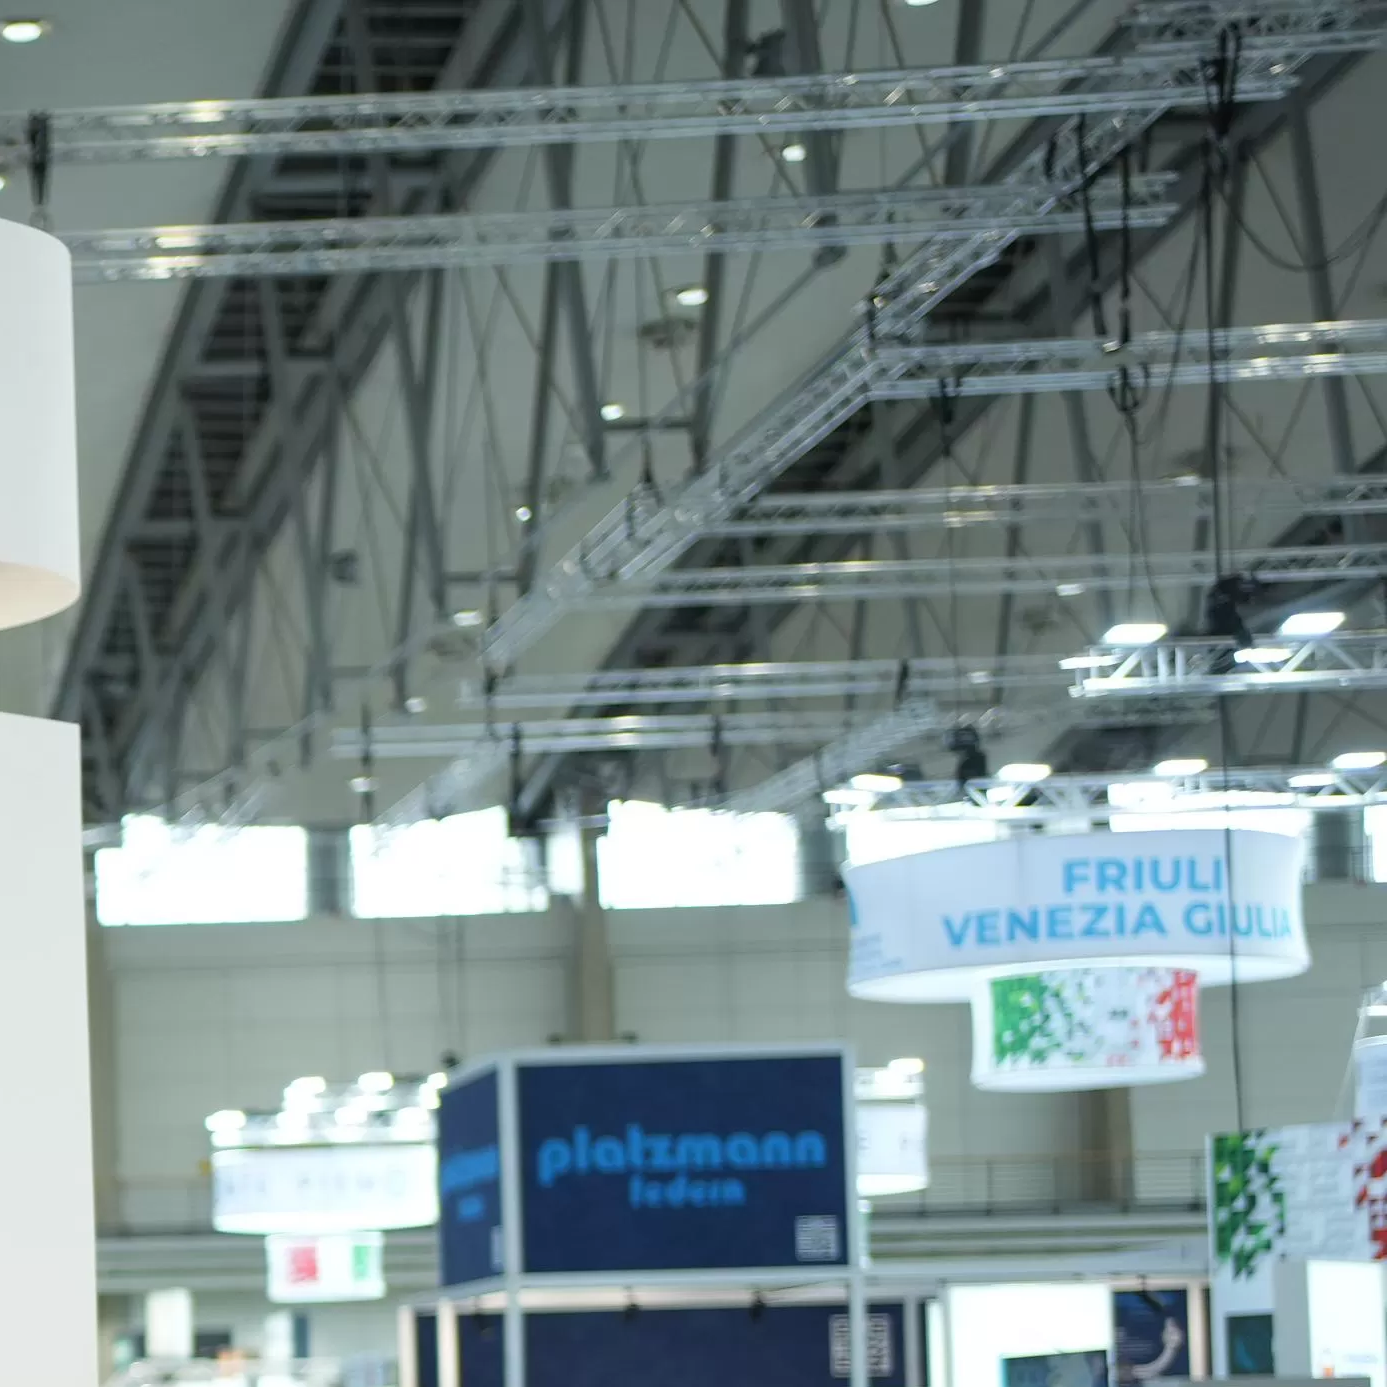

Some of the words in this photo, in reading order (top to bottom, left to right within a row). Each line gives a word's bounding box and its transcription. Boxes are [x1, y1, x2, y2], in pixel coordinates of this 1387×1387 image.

[1062, 856, 1223, 894] FRIULI
[942, 902, 1168, 948] VENEZIA
[537, 1123, 827, 1189] platzmann
